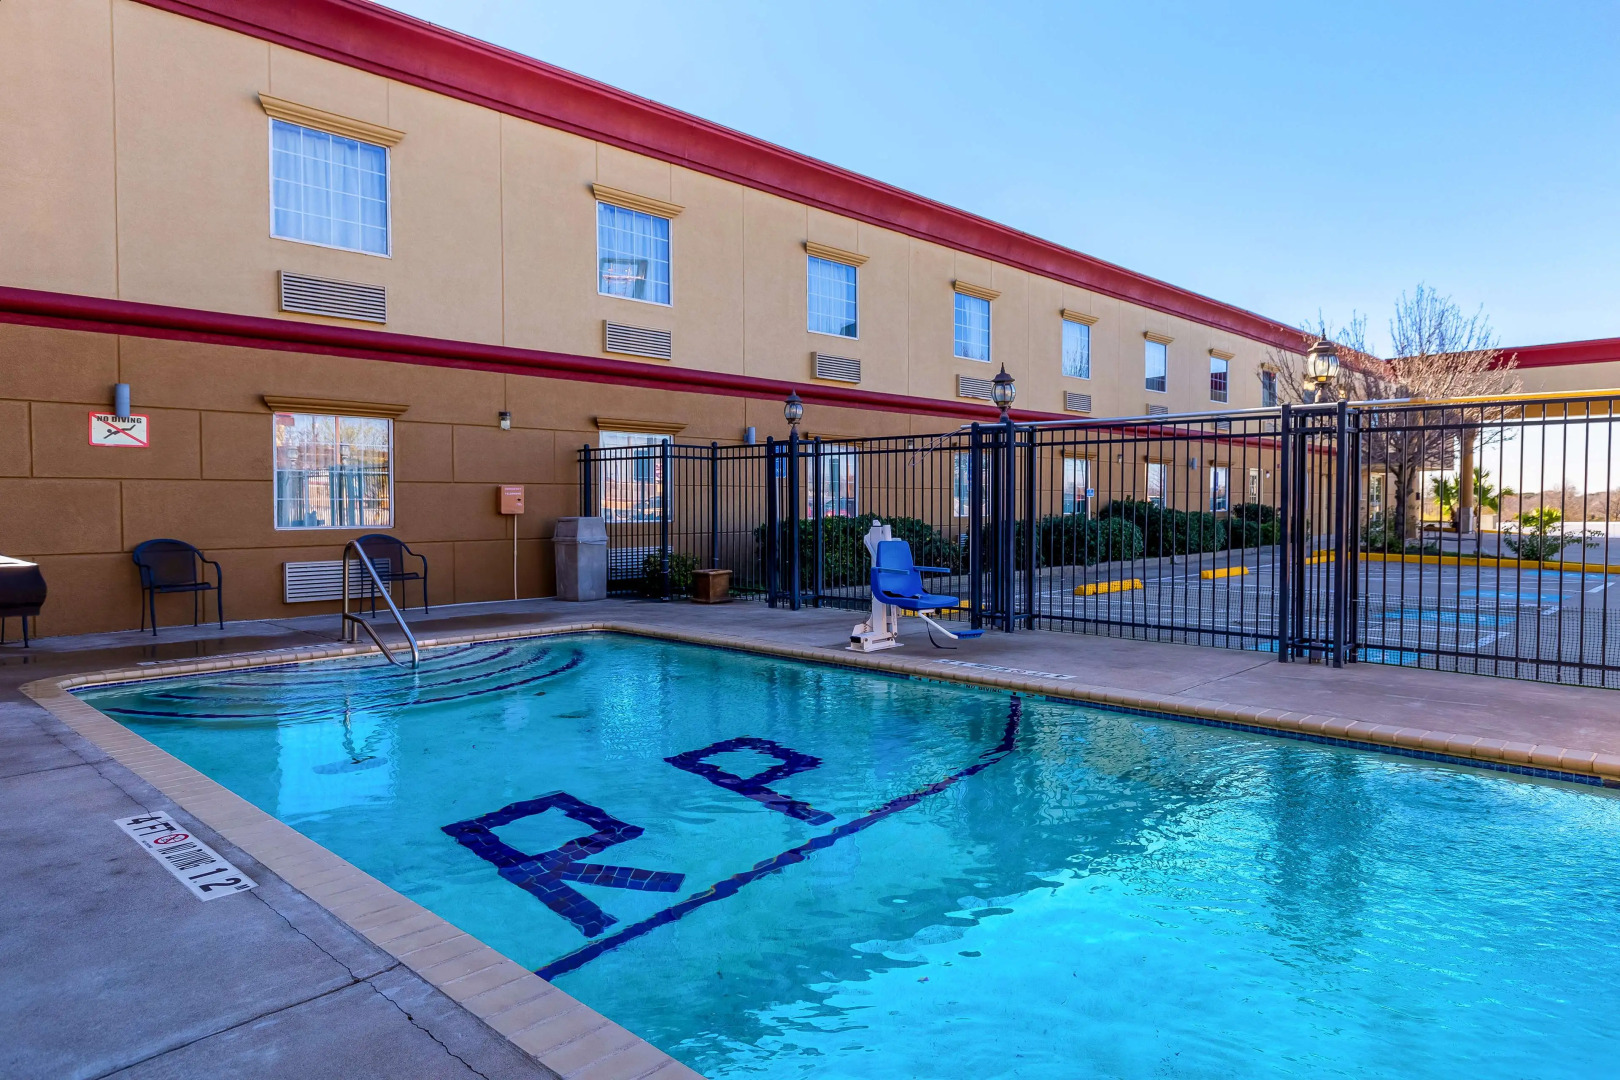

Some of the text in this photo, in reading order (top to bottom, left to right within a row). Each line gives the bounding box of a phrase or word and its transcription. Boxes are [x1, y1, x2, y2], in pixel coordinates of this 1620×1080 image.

[111, 416, 142, 424] DIVING
[126, 816, 163, 826] 4
[132, 821, 178, 837] FT
[440, 735, 836, 938] R P
